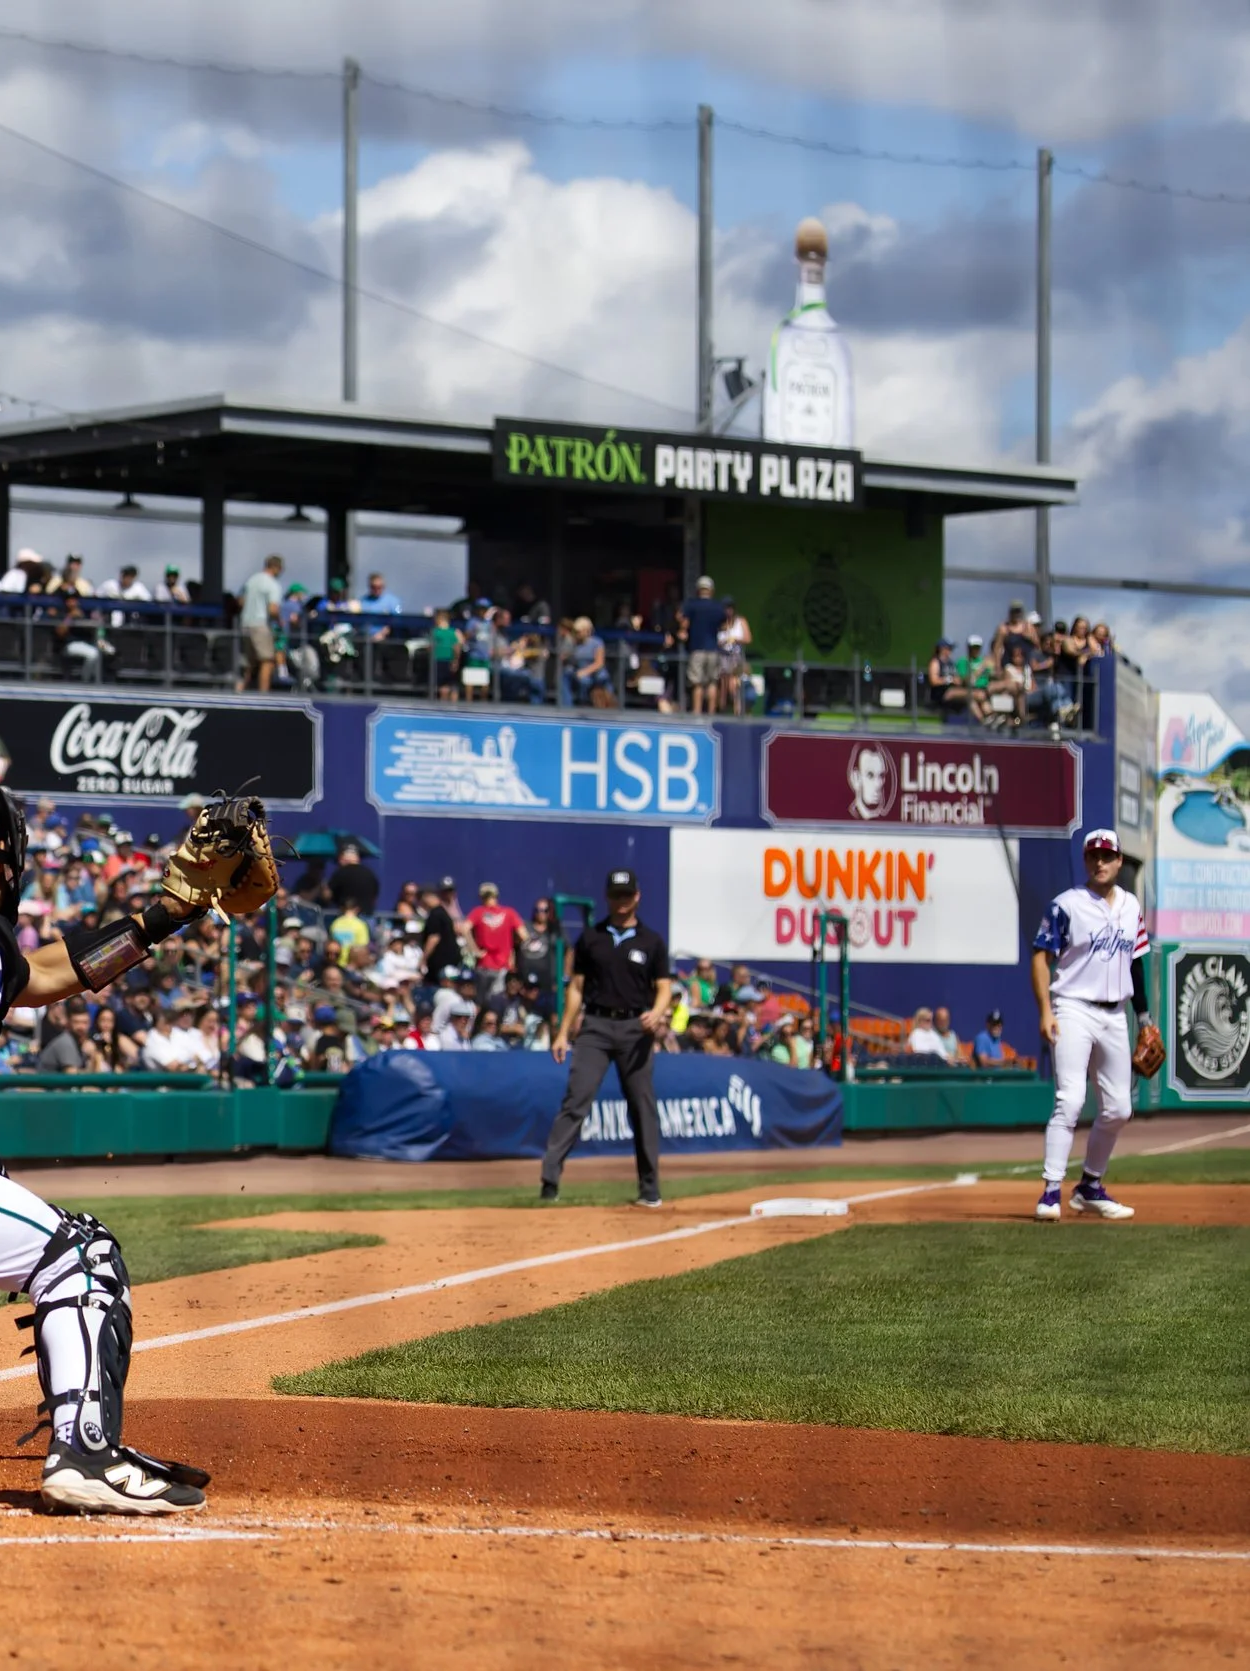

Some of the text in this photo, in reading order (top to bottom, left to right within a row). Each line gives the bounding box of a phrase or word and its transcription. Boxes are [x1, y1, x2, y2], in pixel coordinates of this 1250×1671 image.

[506, 430, 855, 502] PATRÓN PARTY PLAZA
[50, 703, 207, 778] Coca-Cola
[76, 776, 175, 795] ZERO SUGAR
[561, 726, 699, 812] HSB
[901, 751, 1000, 794] Lincoln
[901, 793, 986, 825] Financial
[763, 847, 936, 902] DUNKIN'
[1205, 955, 1248, 998] CLAW
